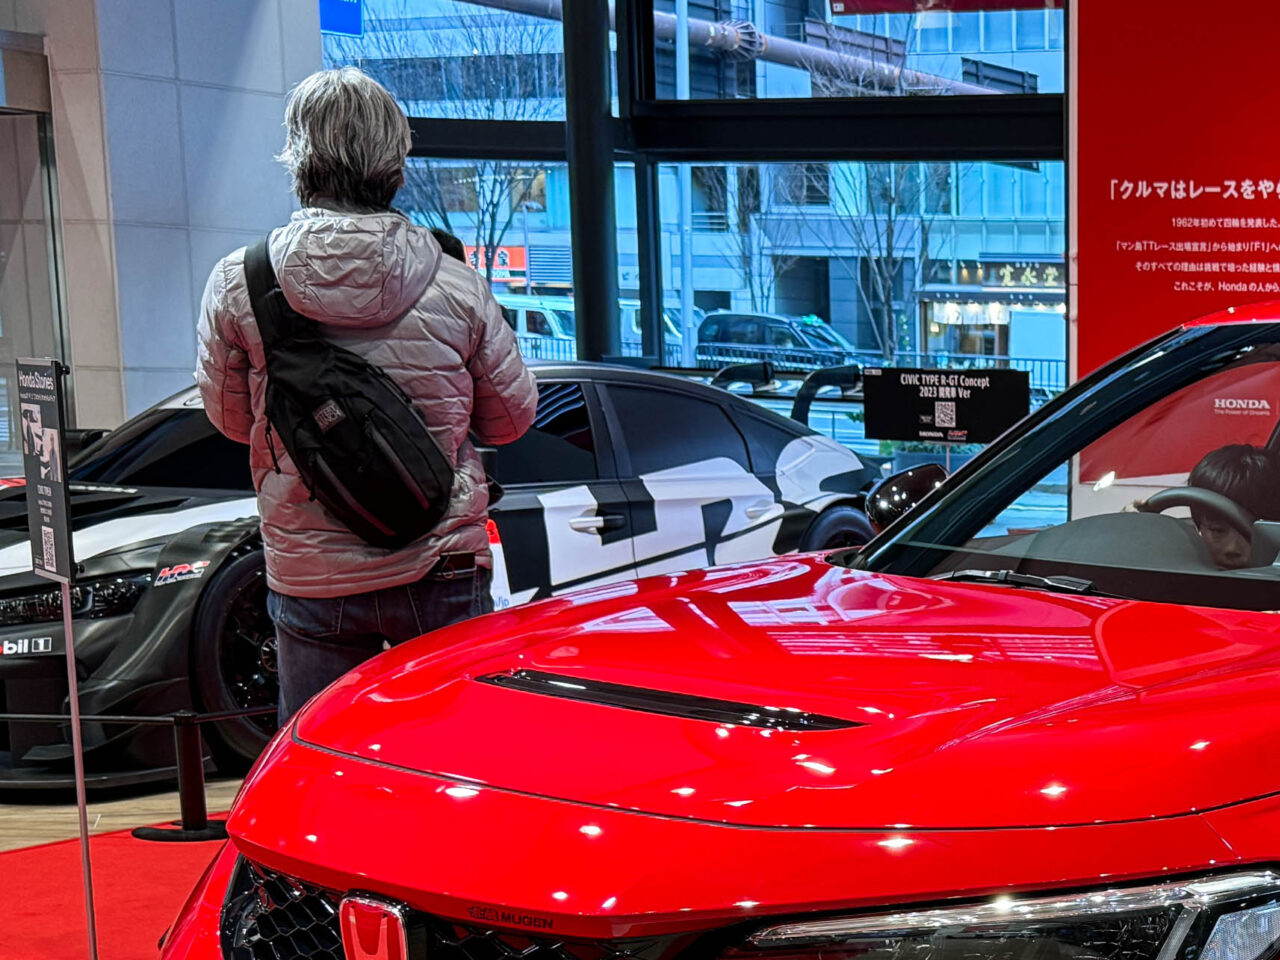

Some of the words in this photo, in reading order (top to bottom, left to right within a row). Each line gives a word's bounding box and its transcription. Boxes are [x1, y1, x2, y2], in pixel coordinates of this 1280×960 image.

[900, 373, 920, 385] CIVIC
[921, 374, 940, 386] TYPE
[940, 375, 959, 386] R-GT
[959, 375, 990, 389] Concept
[919, 386, 937, 398] 2023
[1214, 398, 1271, 409] HONDA
[0, 639, 29, 655] bil
[501, 911, 553, 928] MUGEN
